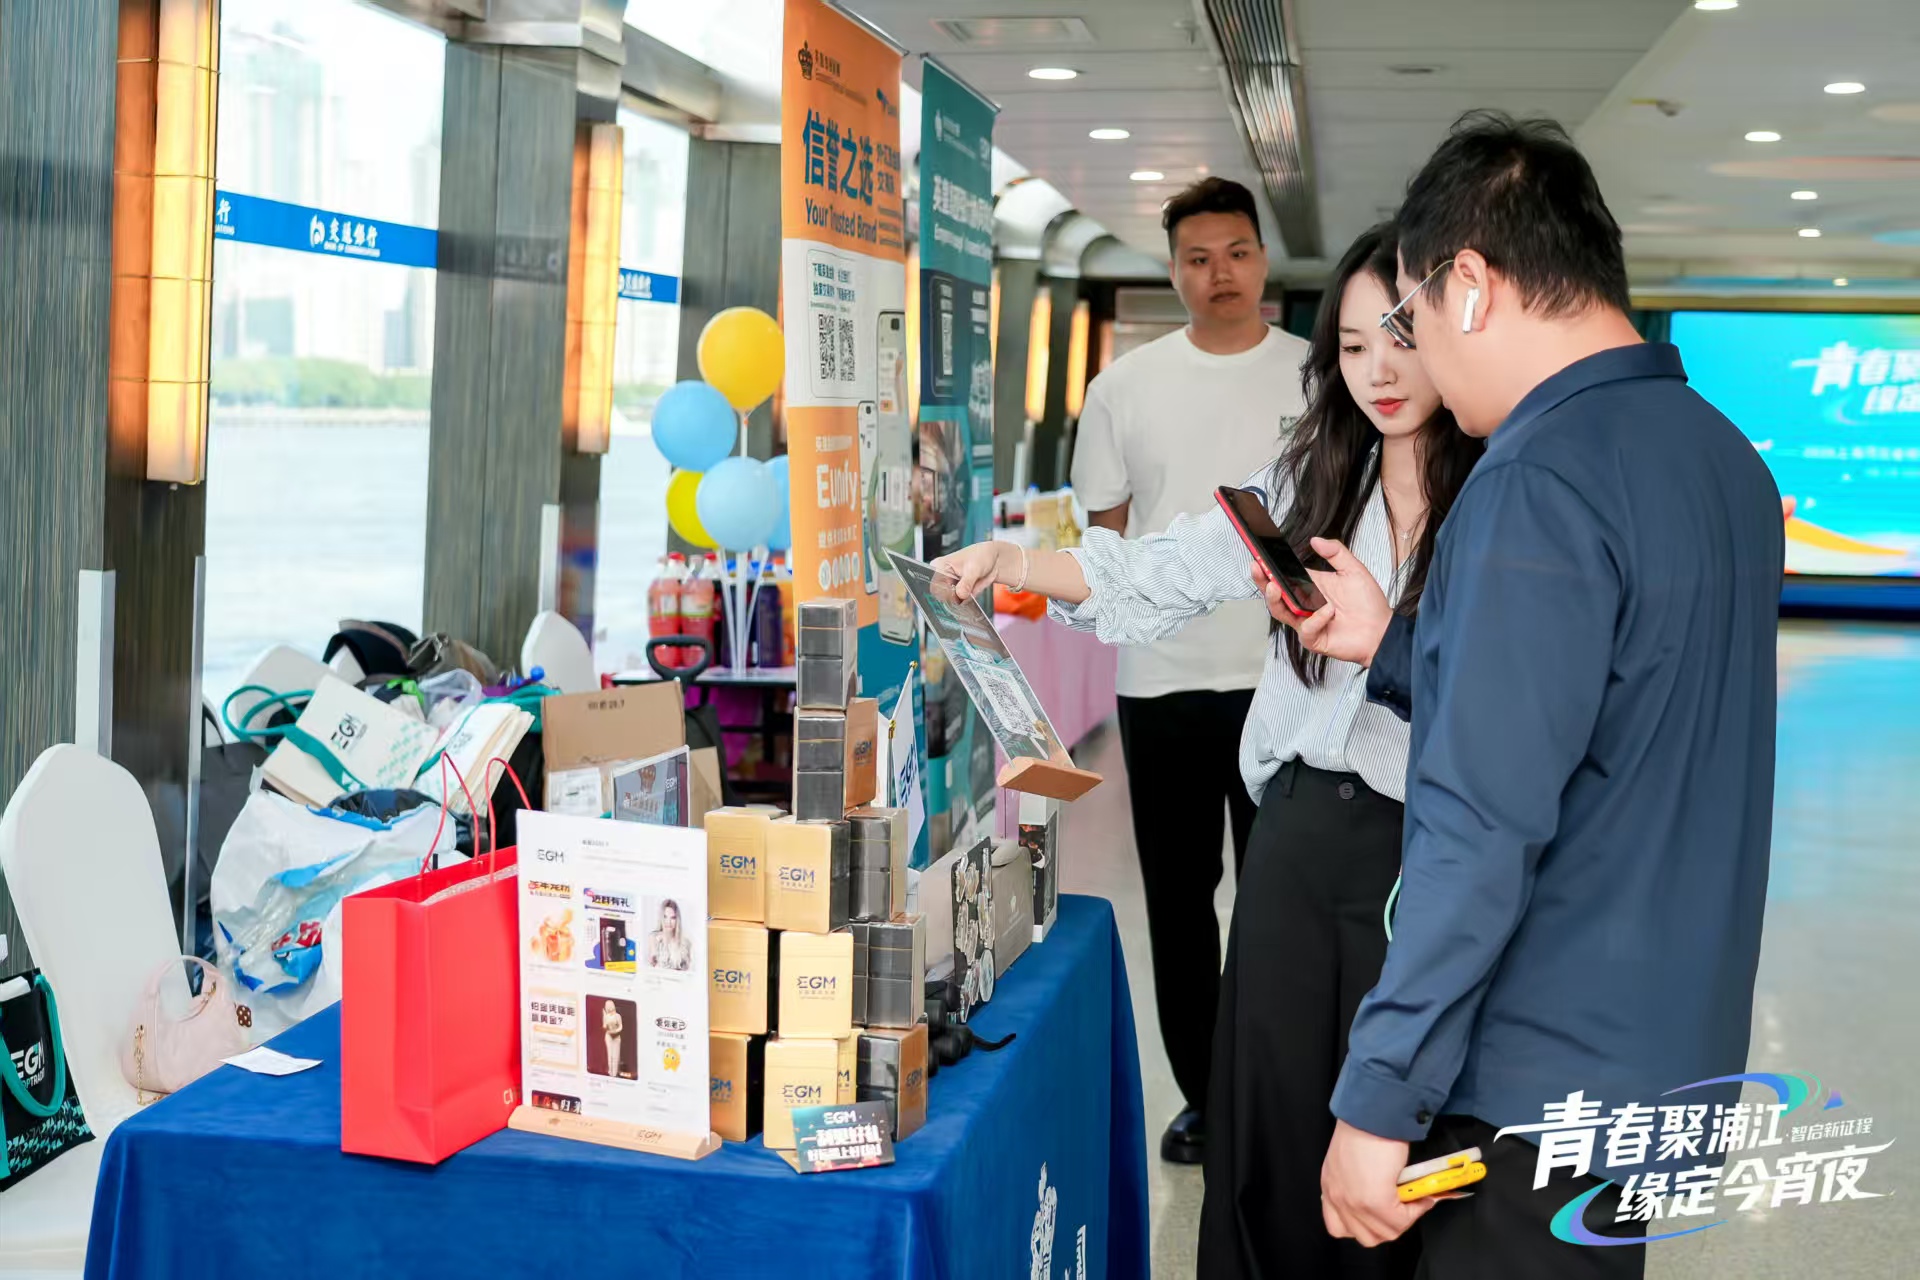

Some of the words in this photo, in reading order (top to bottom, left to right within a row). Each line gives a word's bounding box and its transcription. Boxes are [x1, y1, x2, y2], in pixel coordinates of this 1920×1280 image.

[802, 107, 874, 206] 信誉之选
[805, 197, 828, 228] Your
[536, 849, 565, 863] EGM
[10, 1036, 45, 1080] EGM
[711, 1077, 732, 1092] GM
[823, 1110, 857, 1125] EGM
